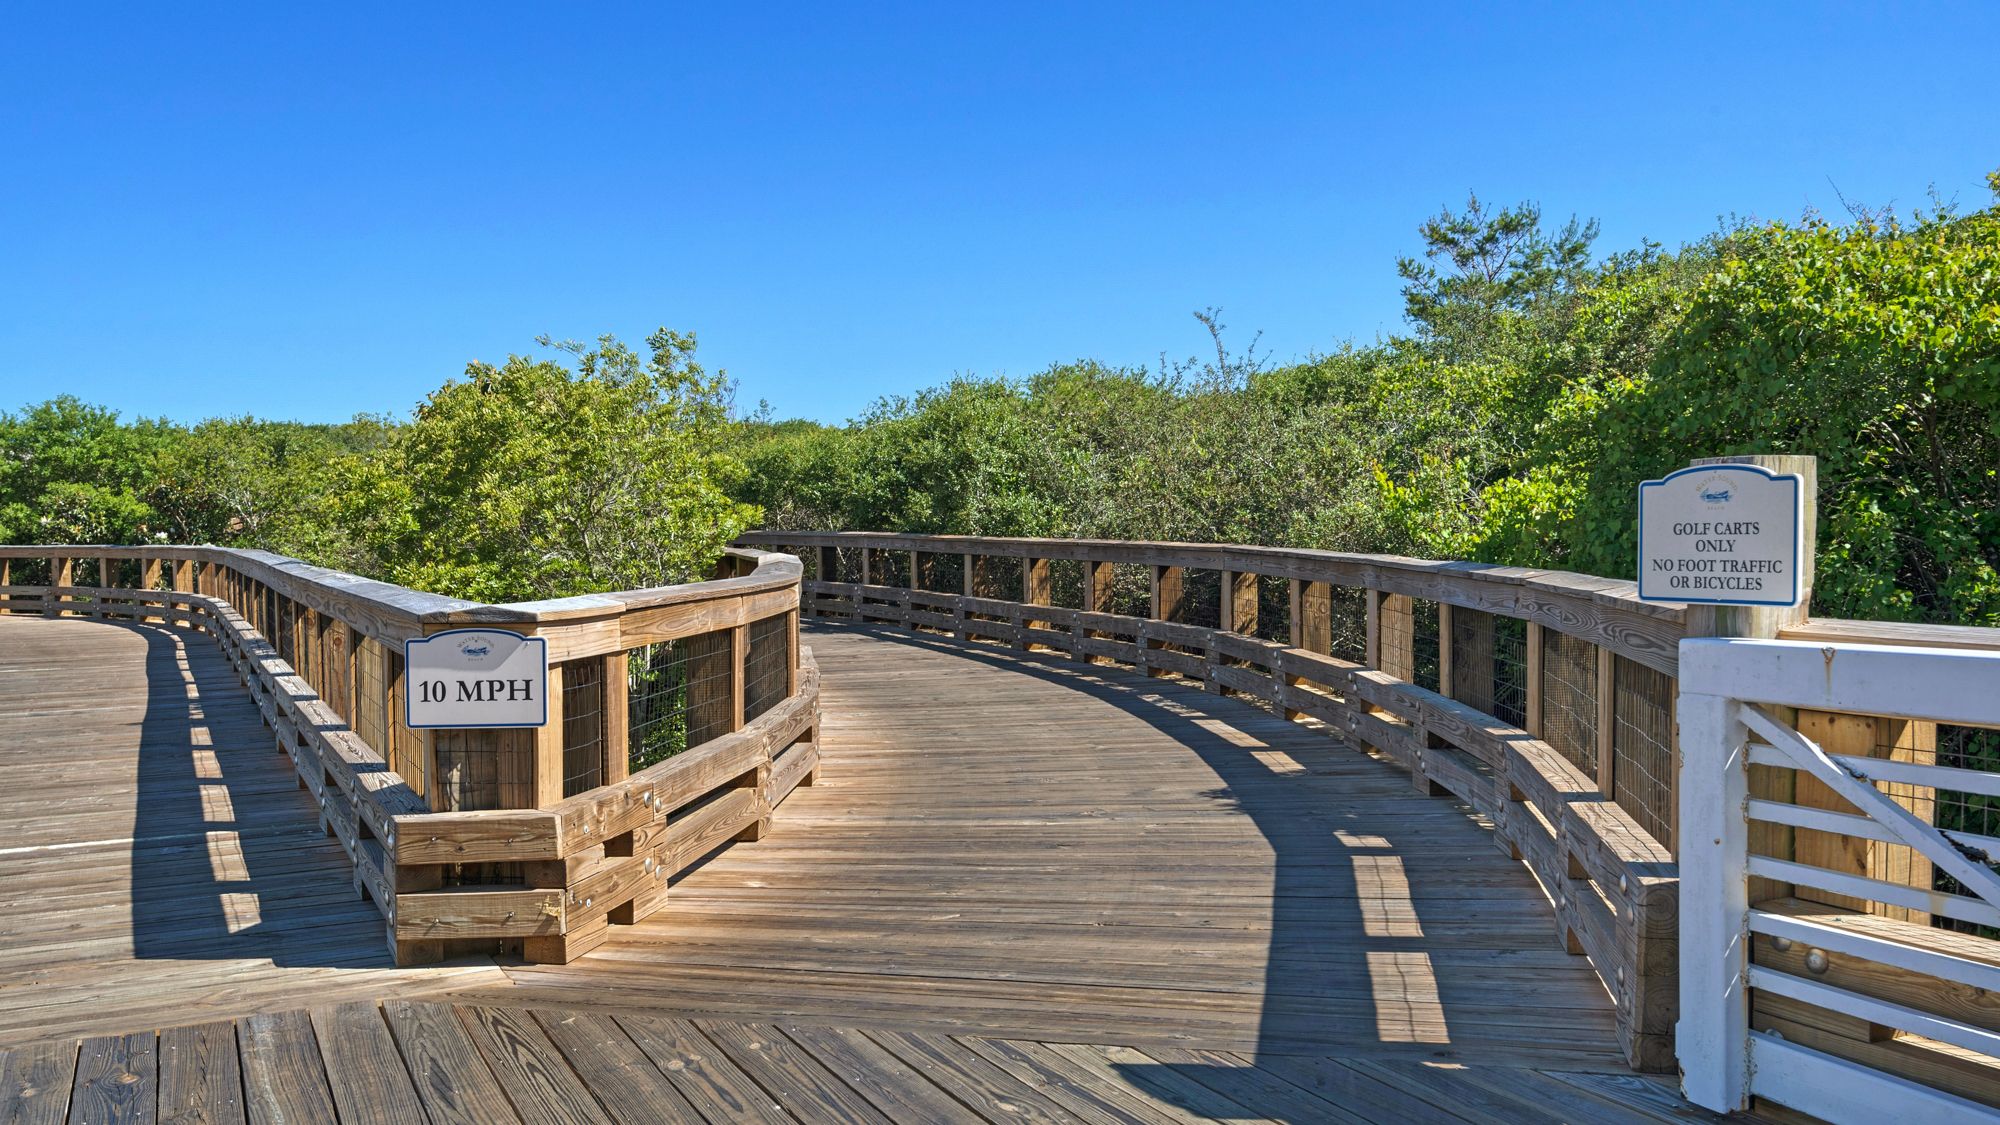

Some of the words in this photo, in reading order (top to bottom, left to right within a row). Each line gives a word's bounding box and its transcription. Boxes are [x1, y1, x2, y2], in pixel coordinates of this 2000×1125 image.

[1673, 522, 1711, 536] GOLF
[1714, 521, 1760, 535] CARTS
[1695, 539, 1736, 553] ONLY
[1652, 559, 1674, 572] NO
[1678, 559, 1718, 573] FOOT
[1720, 559, 1783, 574] TRAFFIC
[1669, 576, 1690, 589] OR
[1694, 576, 1763, 591] BICYCLES
[418, 680, 447, 703] 10
[455, 679, 534, 702] MPH
